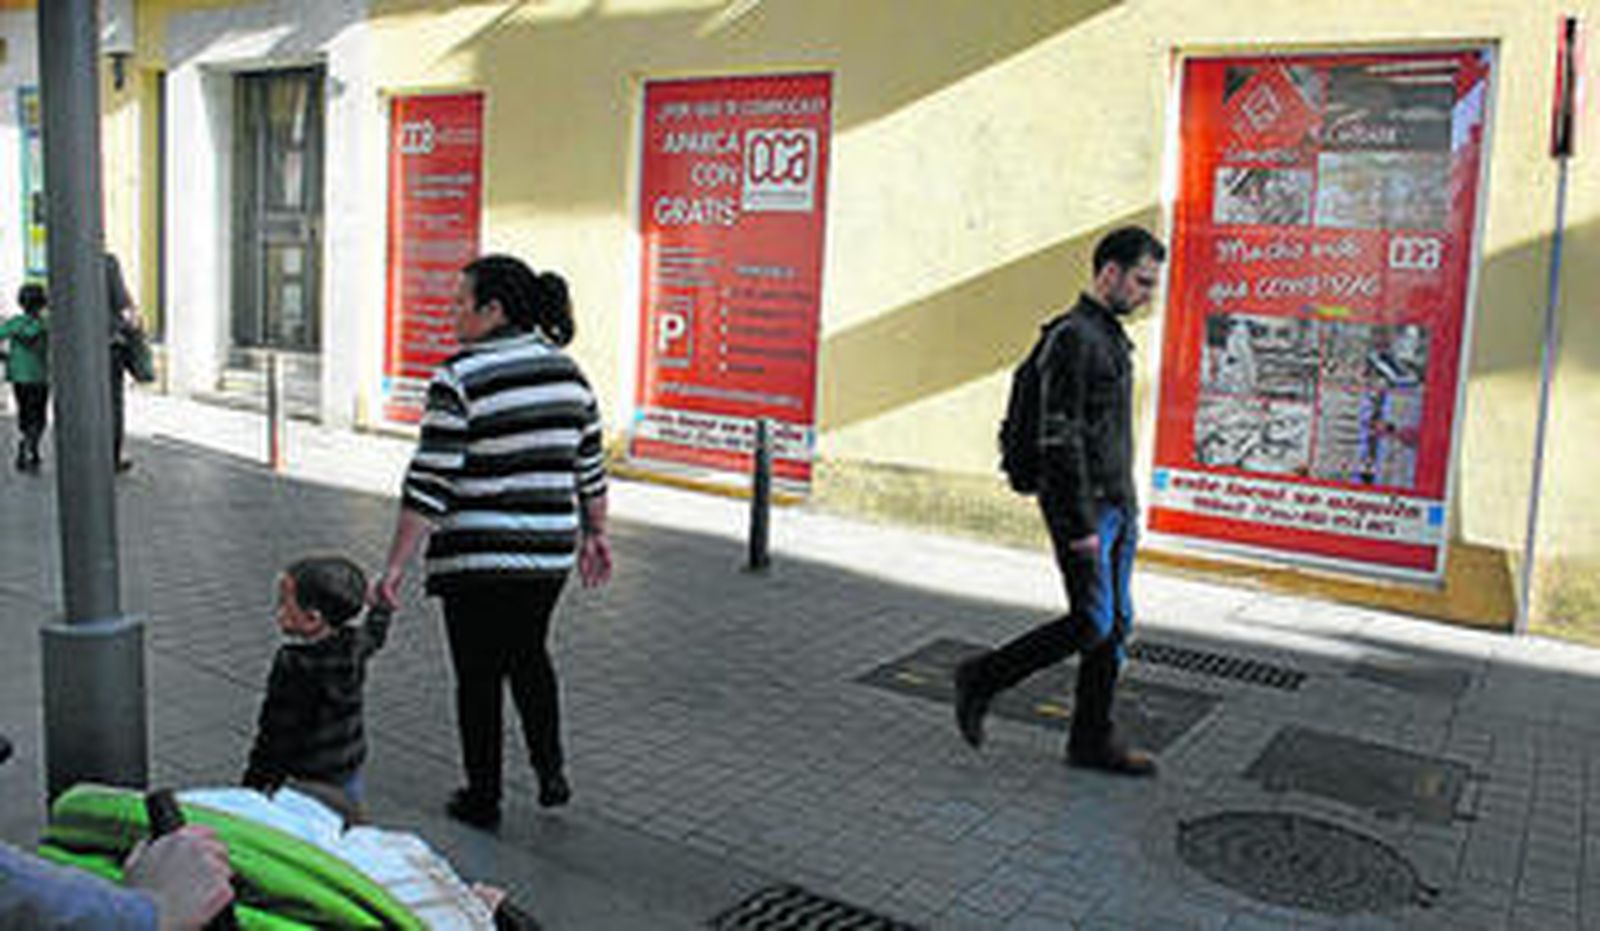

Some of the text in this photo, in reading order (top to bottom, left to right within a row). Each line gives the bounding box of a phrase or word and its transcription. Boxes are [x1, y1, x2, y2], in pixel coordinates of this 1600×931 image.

[690, 161, 738, 188] CON
[653, 195, 739, 227] GRATIS
[658, 313, 686, 353] P
